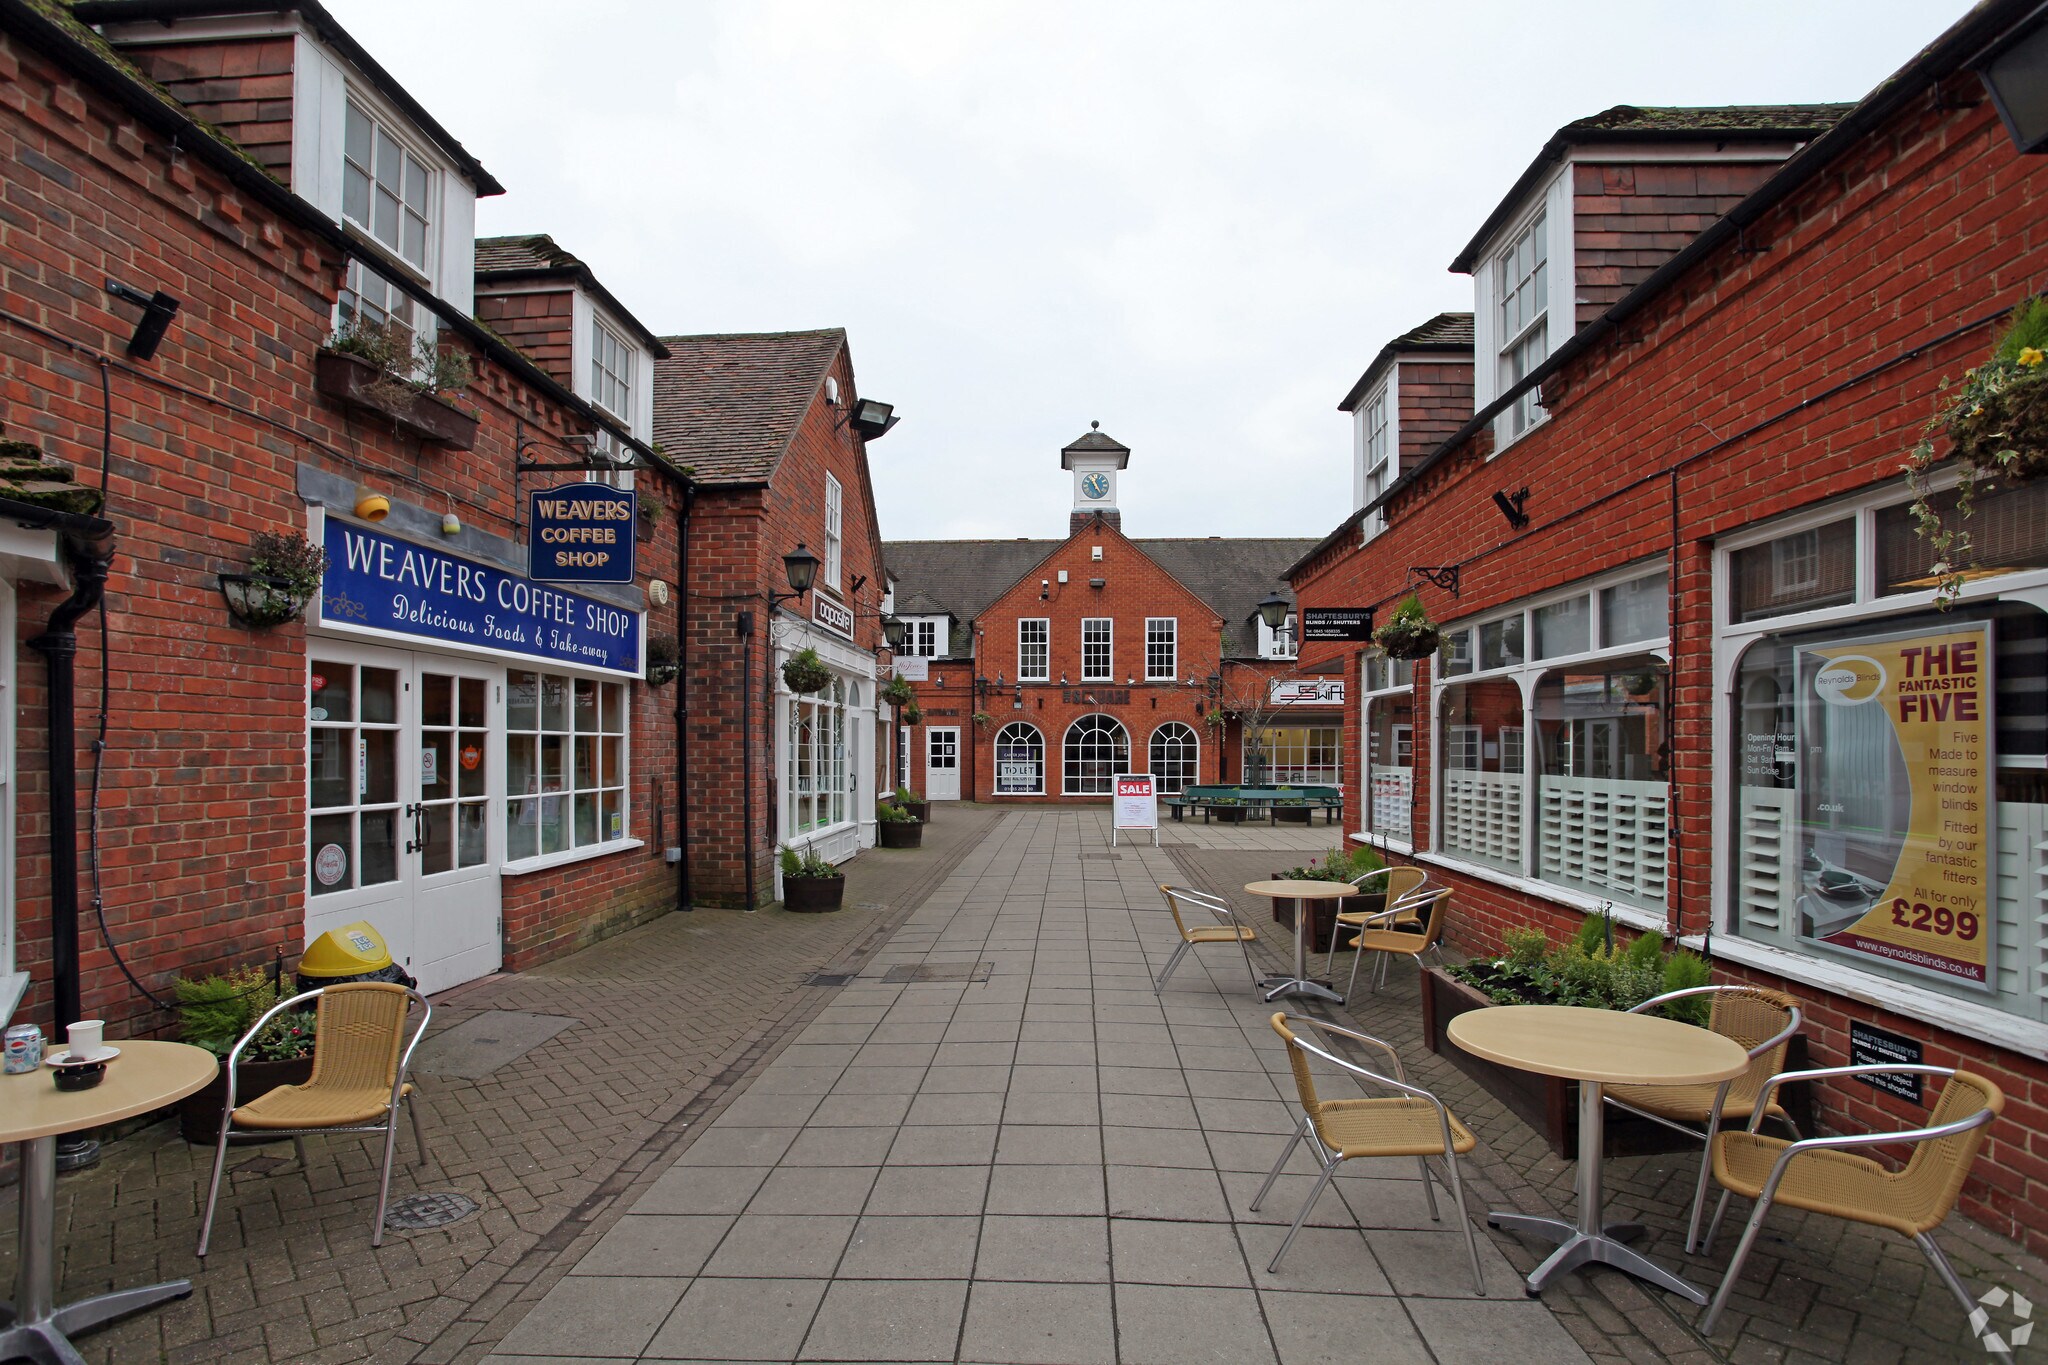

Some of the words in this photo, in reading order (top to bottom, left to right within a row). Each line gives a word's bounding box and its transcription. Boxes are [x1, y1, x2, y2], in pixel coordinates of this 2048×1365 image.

[537, 500, 630, 520] WEAVERS
[541, 528, 616, 543] COFFEE
[555, 552, 609, 567] SHOP
[344, 531, 487, 603] WEAVERS
[498, 578, 575, 626] COFFEE
[585, 604, 630, 638] SHOP
[392, 594, 475, 636] Delicious
[484, 615, 526, 643] Foods
[535, 626, 543, 647] &
[550, 630, 608, 665] Take-away
[1901, 641, 1977, 678] THE
[1818, 676, 1854, 686] Reynolds
[1856, 673, 1880, 682] Blinds
[1899, 676, 1976, 692] FANTASTIC
[1073, 690, 1130, 704] SQUARE
[1899, 692, 1978, 723] FIVE
[1747, 733, 1775, 743] Opening
[1777, 733, 1795, 741] Hour
[1954, 732, 1977, 743] Five
[1930, 748, 1962, 760] Made
[1966, 750, 1977, 760] to
[1747, 766, 1759, 775] Sun
[1929, 766, 1977, 777] measure
[1120, 785, 1150, 794] SALE
[1933, 782, 1977, 794] window
[1942, 798, 1977, 811] blinds
[1944, 821, 1977, 834] Fitted
[1939, 836, 1953, 850] by
[1956, 841, 1977, 851] our
[1926, 851, 1977, 868] fantastic
[1943, 869, 1977, 885] fitters
[1914, 887, 1928, 900] All
[1930, 889, 1947, 903] for
[1950, 896, 1978, 911] only
[1856, 940, 1978, 978] www.reynoldsblinds.co.uk
[1852, 1029, 1918, 1058] SHAFTESBURYS
[1856, 1051, 1876, 1063] Please
[1878, 1047, 1907, 1061] SHUTTERS
[1875, 1077, 1886, 1087] this
[1887, 1082, 1918, 1100] shopfront
[1892, 1075, 1912, 1087] object
